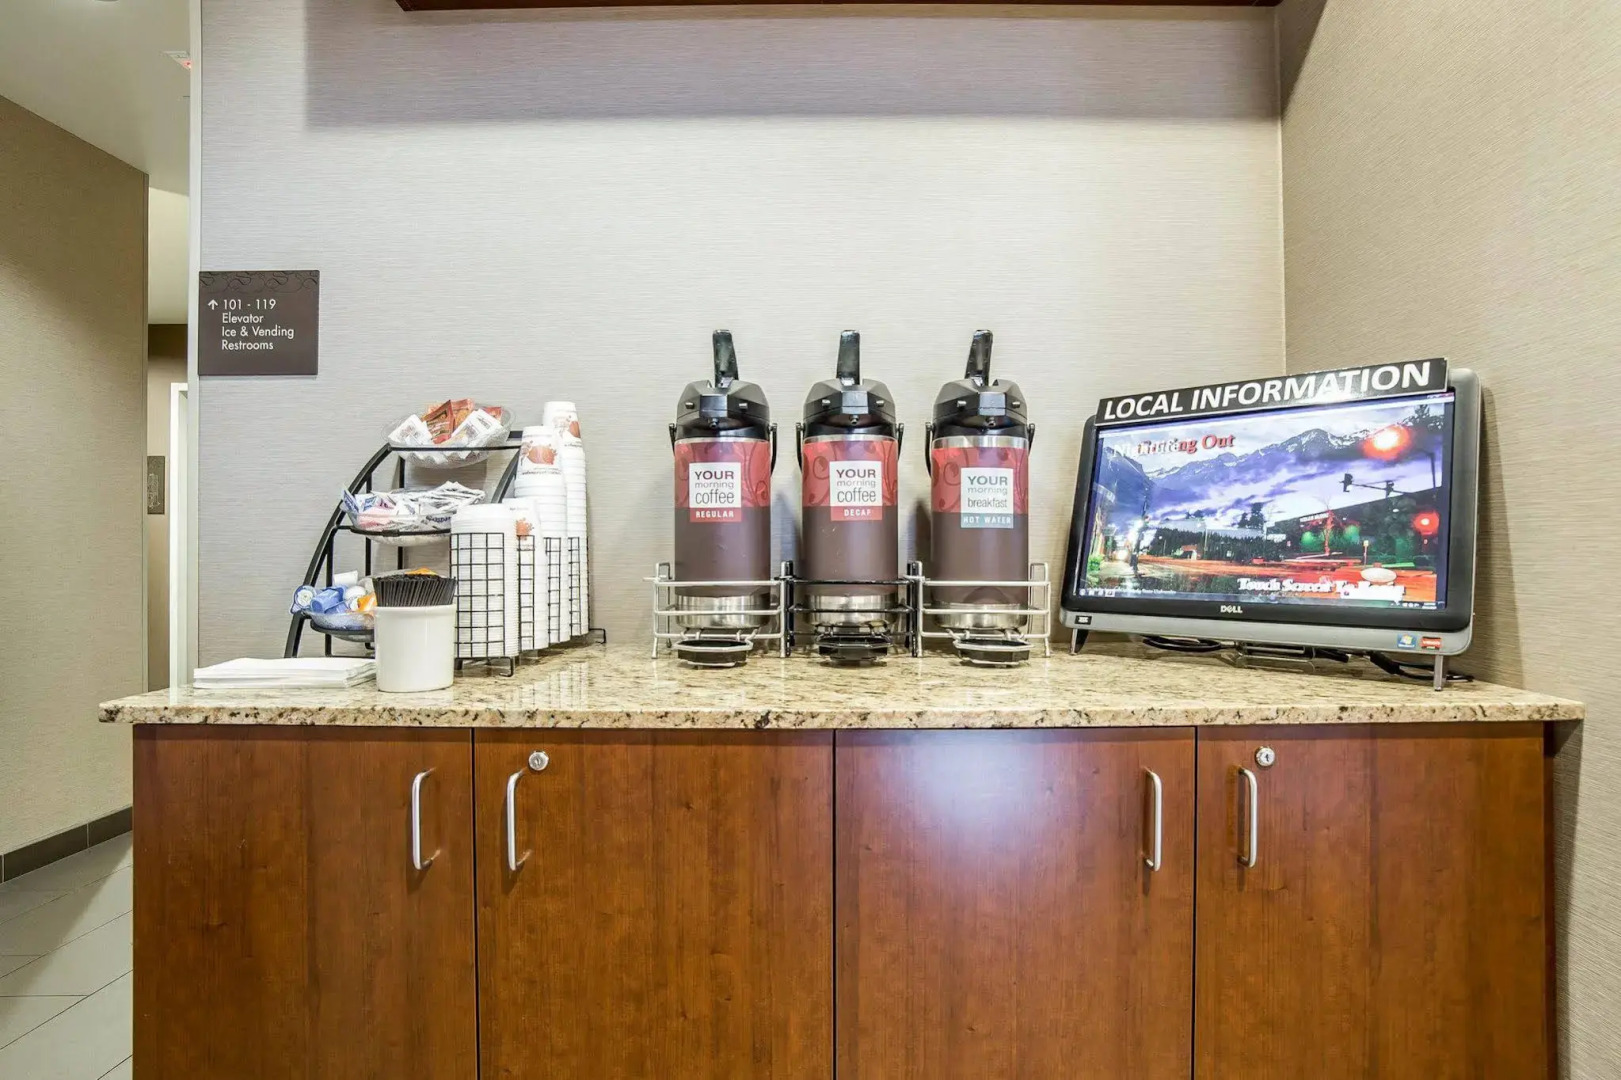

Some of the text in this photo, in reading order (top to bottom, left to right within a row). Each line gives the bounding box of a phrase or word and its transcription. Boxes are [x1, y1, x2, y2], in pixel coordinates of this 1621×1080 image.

[223, 299, 242, 310] 101
[255, 299, 277, 310] 119
[222, 312, 264, 324] Elevator
[221, 325, 295, 339] Ice & Vending
[221, 340, 274, 350] Restrooms
[1104, 361, 1431, 420] LOCAL INFORMATION
[1202, 433, 1235, 450] Out
[694, 470, 735, 480] YOUR
[836, 469, 876, 479] YOUR
[836, 479, 876, 488] morning
[967, 475, 1008, 486] YOUR
[694, 482, 735, 490] morning
[695, 488, 735, 504] coffee
[837, 487, 876, 503] coffee
[967, 488, 1008, 496] morning
[967, 497, 1008, 508] breakfast
[695, 510, 735, 518] REGULAR
[843, 508, 871, 517] DECAF
[963, 516, 1011, 524] HOT WATER
[1220, 604, 1243, 614] DELL
